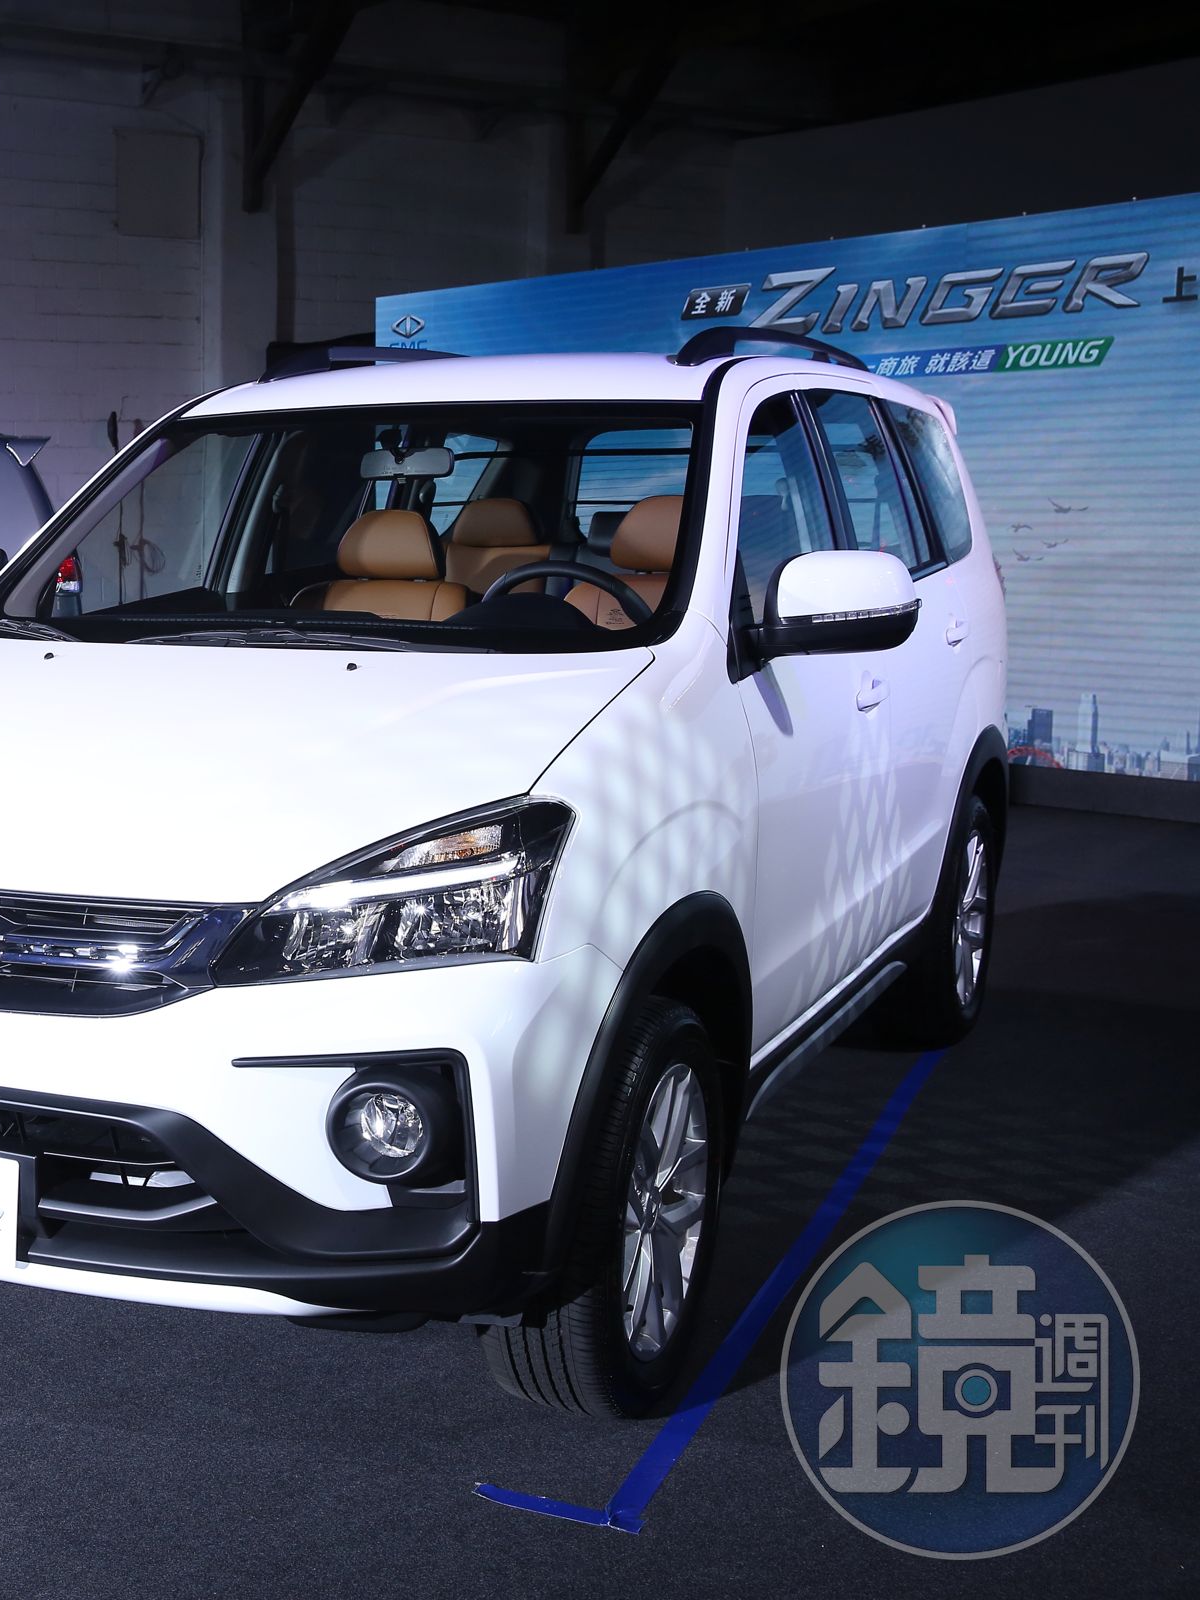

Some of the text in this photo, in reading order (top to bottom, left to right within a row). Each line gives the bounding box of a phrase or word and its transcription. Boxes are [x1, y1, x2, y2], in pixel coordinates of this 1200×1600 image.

[691, 252, 1199, 336] 全新 ZINGER 上
[1004, 340, 1105, 369] YOUNG
